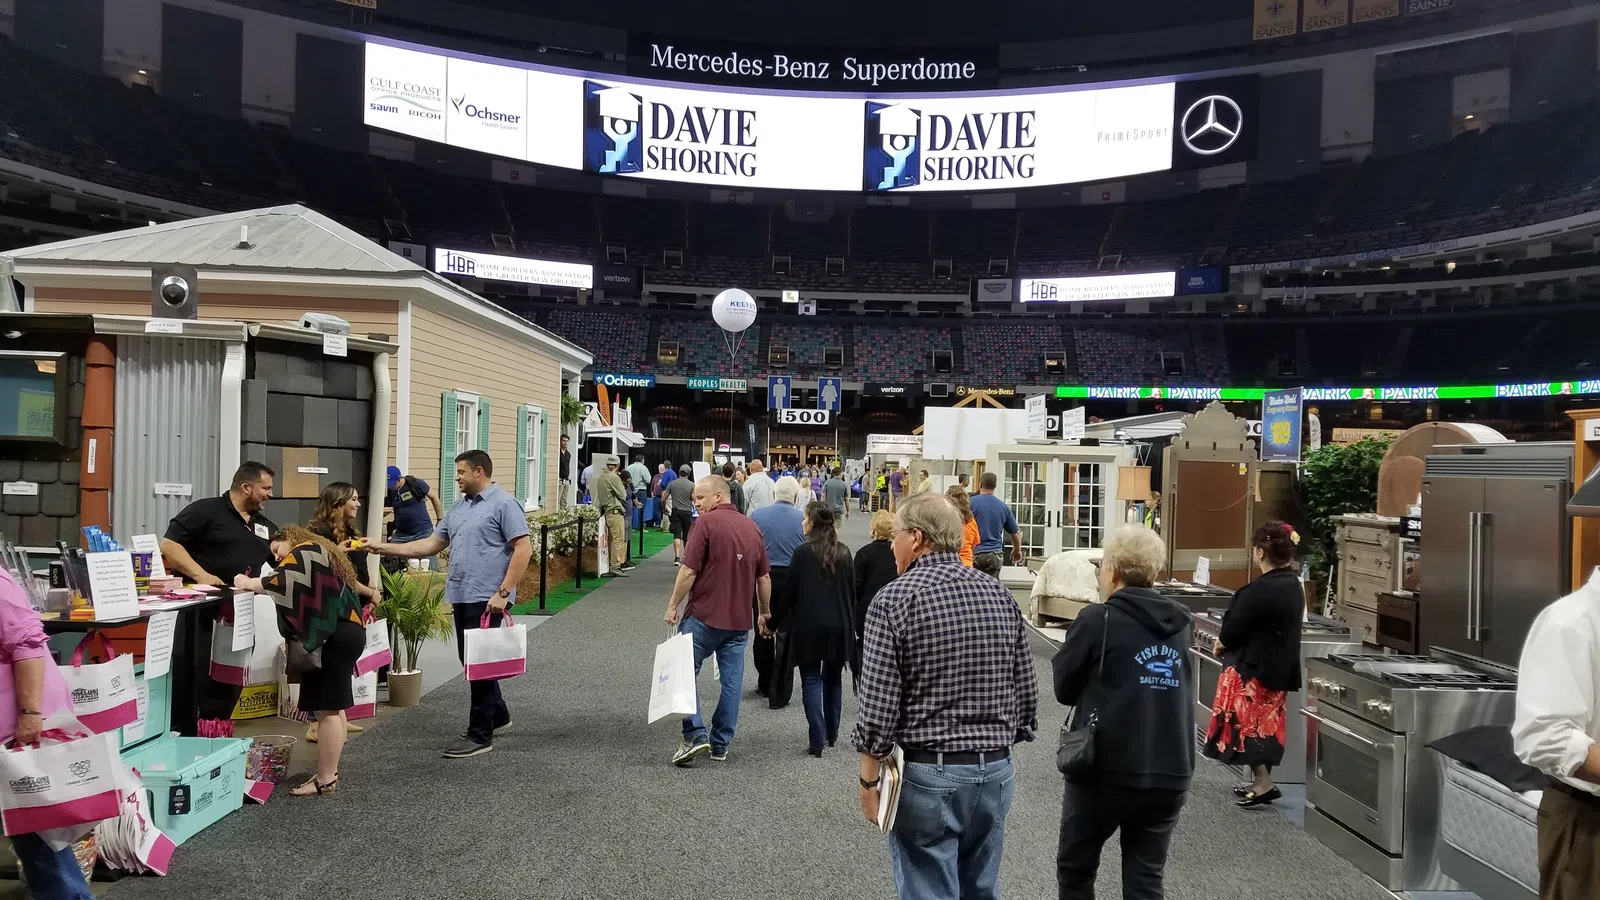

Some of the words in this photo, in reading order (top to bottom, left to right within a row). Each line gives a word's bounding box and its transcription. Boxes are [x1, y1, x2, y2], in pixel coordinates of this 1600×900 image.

[1409, 0, 1450, 12] SAINTS
[1355, 8, 1396, 21] SAINTS
[1256, 25, 1294, 37] SAINTS
[1306, 18, 1345, 31] SAINTS
[650, 44, 830, 79] Mercedes-Benz
[843, 57, 976, 86] Superdome
[370, 77, 402, 90] GULF
[403, 82, 442, 97] COAST
[370, 86, 398, 95] OFFICE
[400, 91, 442, 102] PRODUCTS
[370, 102, 399, 114] savin
[408, 109, 441, 120] RICOH
[465, 104, 521, 124] Ochsner
[481, 121, 499, 129] Health
[500, 123, 519, 131] System
[649, 101, 758, 148] DAVIE
[926, 110, 1037, 151] DAVIE
[646, 144, 758, 177] SHORING
[924, 153, 1036, 182] SHORING
[446, 251, 475, 274] HBA
[477, 263, 500, 271] HOME
[502, 265, 539, 275] BUILDERS
[540, 269, 591, 280] ASSOCIATION
[495, 272, 529, 281] GREATER
[550, 278, 585, 286] ORLEANS
[603, 274, 630, 283] verizon
[1031, 280, 1058, 299] HBA
[604, 374, 650, 387] Ochsner
[689, 379, 719, 389] PEOPLES
[720, 380, 746, 389] HEALTH
[1087, 387, 1141, 399] BARK
[1168, 387, 1222, 400] PARK
[1381, 387, 1439, 400] PARK
[1496, 383, 1551, 398] BARK
[785, 410, 826, 423] 500
[1134, 645, 1159, 665] FISH
[1160, 644, 1182, 669] DIVA
[1139, 675, 1160, 685] SALTY
[1159, 678, 1180, 688] GIRLS
